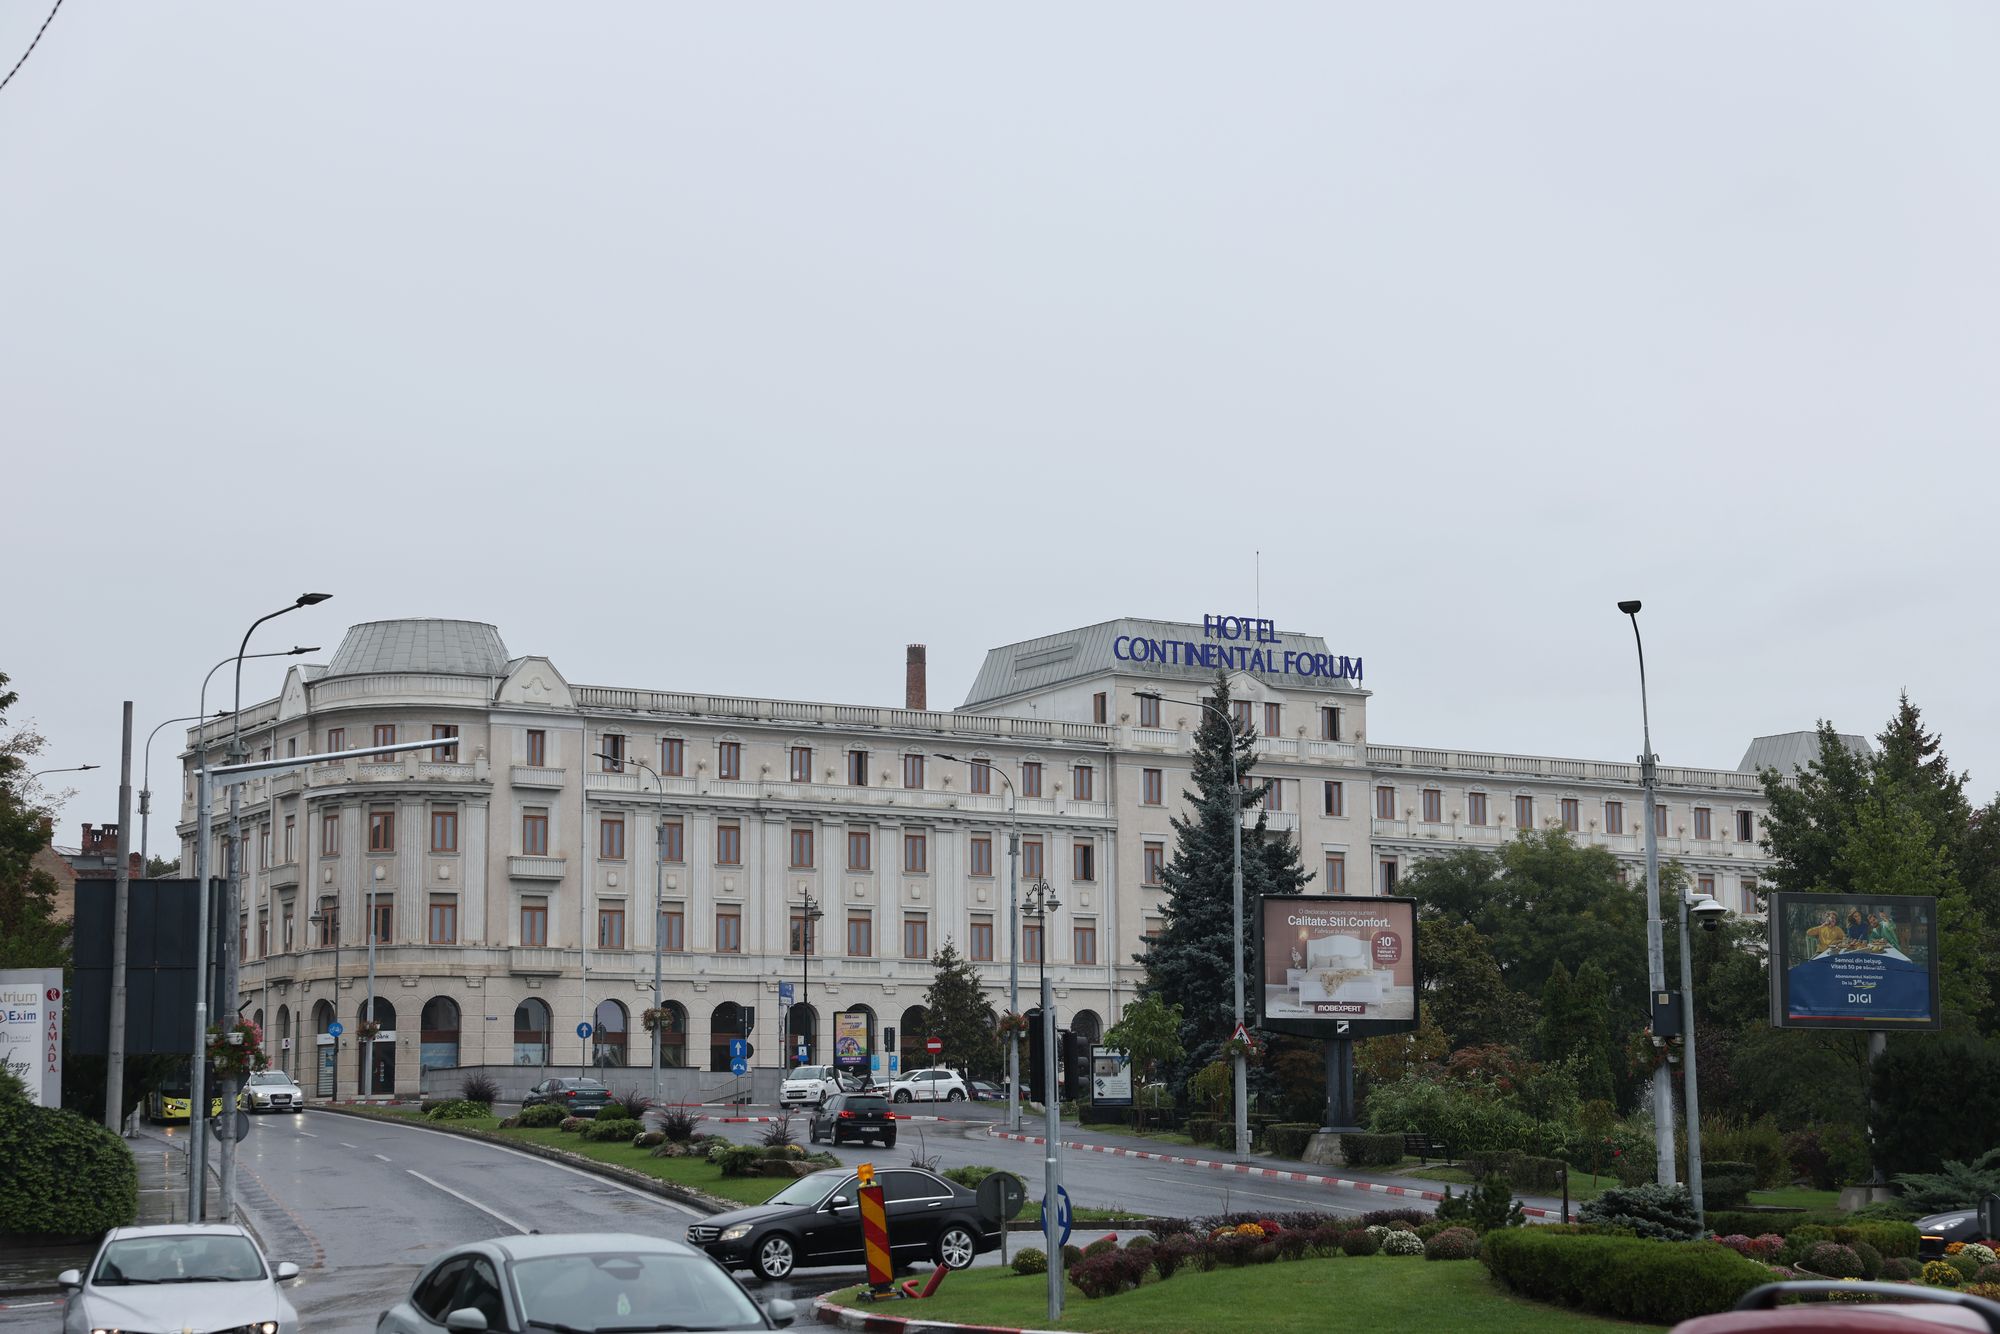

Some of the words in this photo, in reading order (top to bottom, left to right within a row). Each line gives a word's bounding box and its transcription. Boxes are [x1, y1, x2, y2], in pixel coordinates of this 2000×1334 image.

[1203, 613, 1282, 643] HOTEL
[1113, 635, 1280, 674] CONTINENTAL
[1283, 650, 1363, 680] FORUM
[0, 991, 37, 1002] trium
[1848, 993, 1872, 1004] DIGI
[9, 1010, 37, 1021] Exim
[48, 1011, 58, 1073] RAMADA
